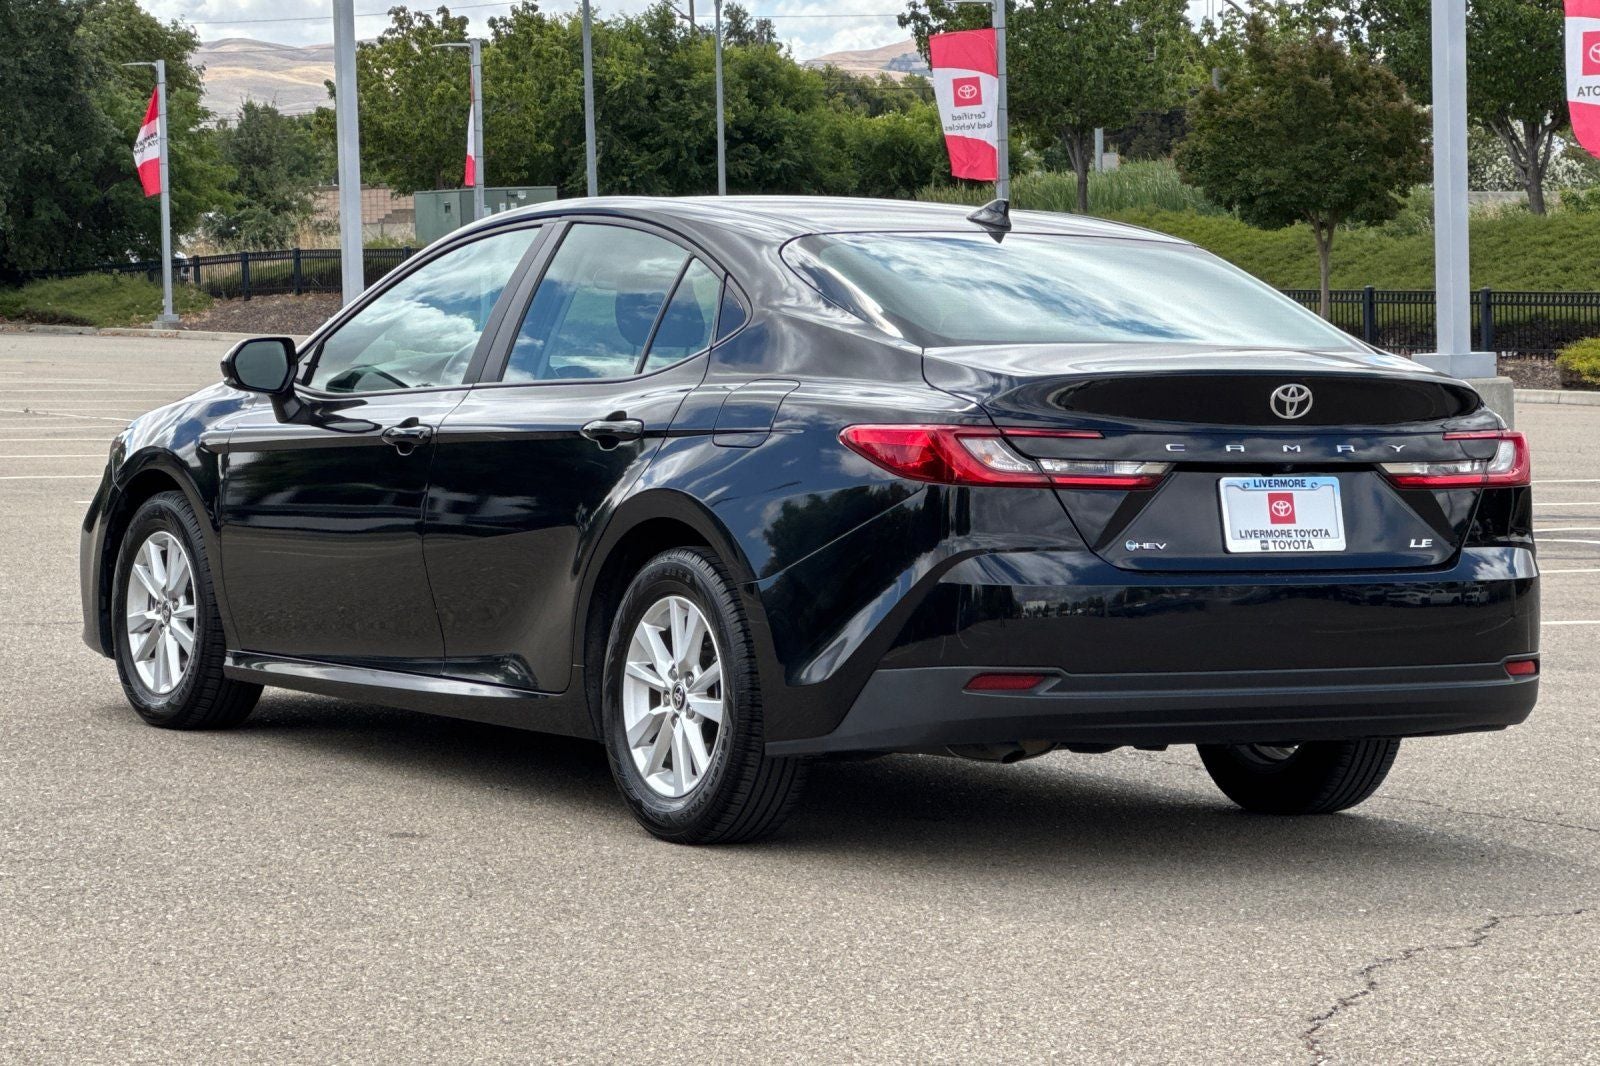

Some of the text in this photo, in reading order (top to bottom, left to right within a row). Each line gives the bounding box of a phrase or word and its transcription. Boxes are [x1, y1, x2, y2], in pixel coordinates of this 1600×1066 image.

[1165, 443, 1406, 453] CAMRY
[1253, 479, 1307, 488] LIVERMORE
[1239, 528, 1330, 539] LIVERMORE TOYOTA
[1135, 542, 1167, 550] HEV
[1272, 540, 1314, 550] TOYOTA
[1409, 538, 1433, 548] LE
